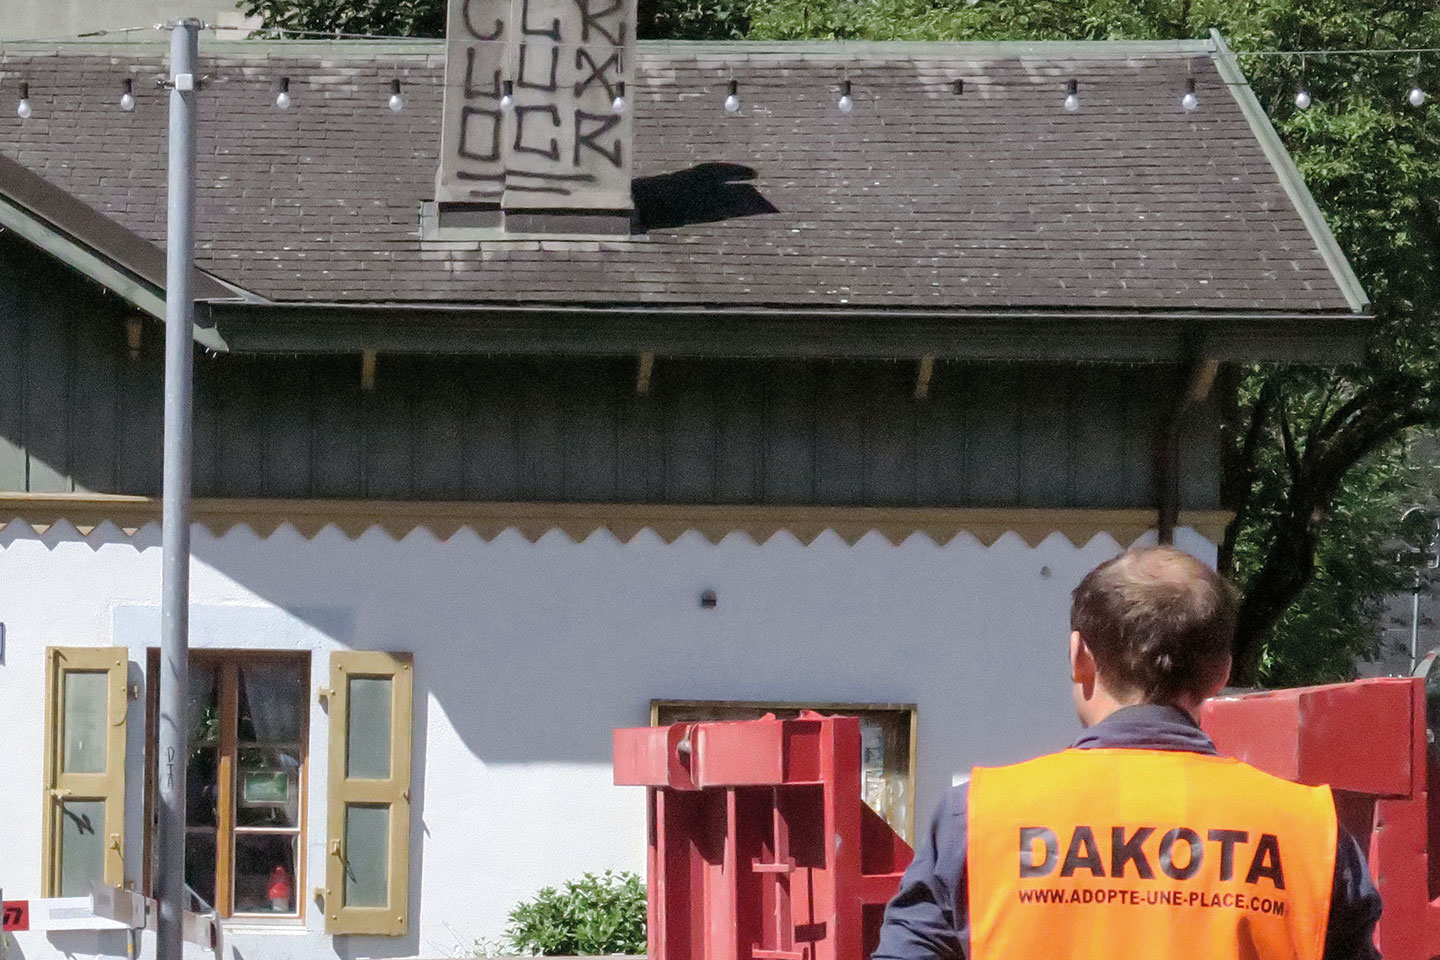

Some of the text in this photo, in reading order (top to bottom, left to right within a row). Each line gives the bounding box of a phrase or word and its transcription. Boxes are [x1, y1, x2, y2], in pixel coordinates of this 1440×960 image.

[458, 105, 623, 168] OCR
[1018, 826, 1286, 890] DAKOTA
[1018, 889, 1286, 916] WWW.ADOPTE-UNE-PLACE.COM
